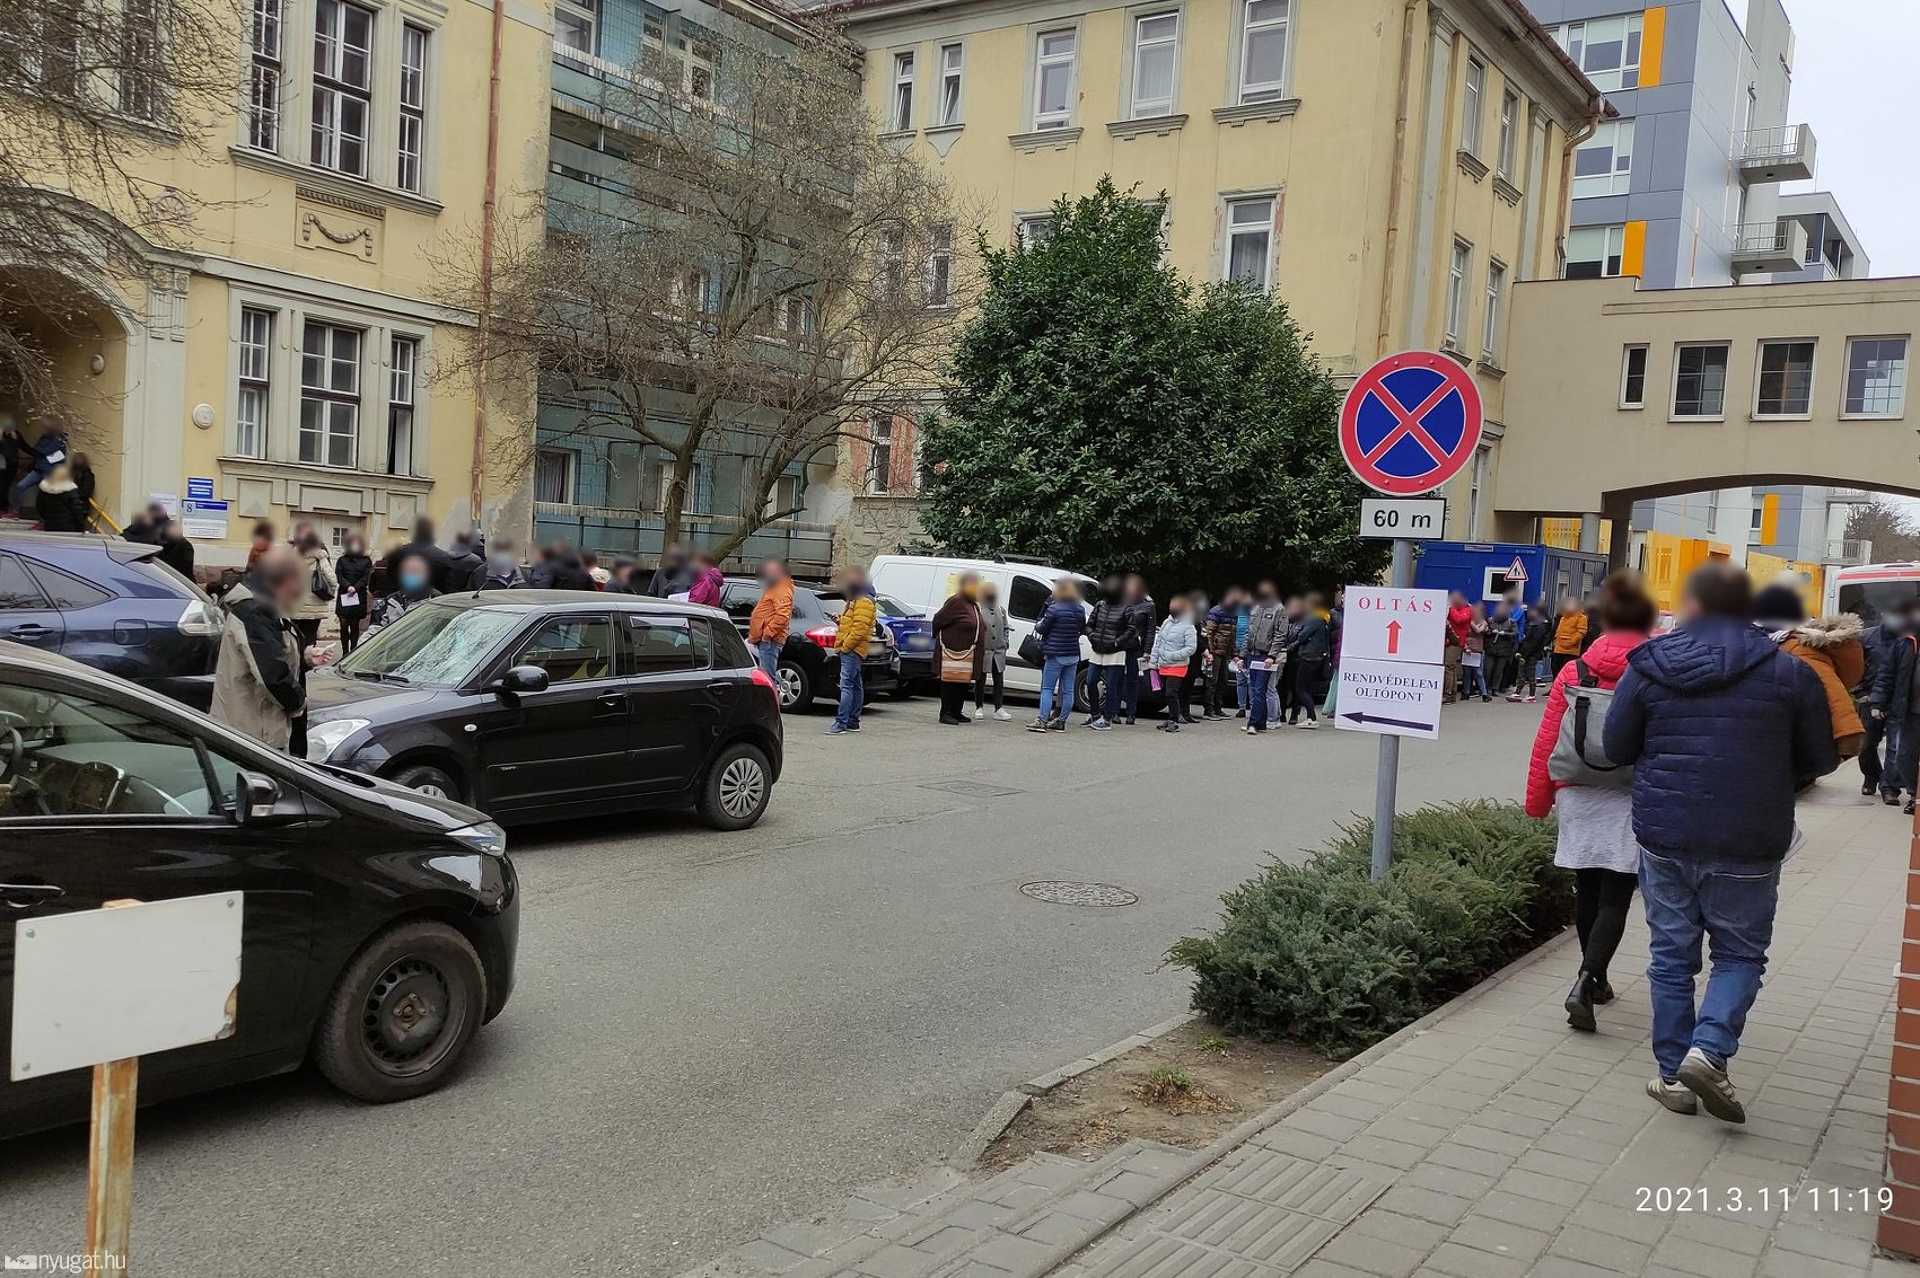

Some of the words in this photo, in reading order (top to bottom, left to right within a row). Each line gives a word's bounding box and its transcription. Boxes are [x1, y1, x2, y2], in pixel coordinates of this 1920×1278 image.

[187, 503, 193, 513] 8
[1374, 510, 1399, 527] 60
[1411, 514, 1431, 528] m
[1359, 595, 1432, 613] OLTÁS
[1343, 672, 1439, 690] RENDVÉDELEM
[1355, 686, 1424, 702] OLTÓPONT
